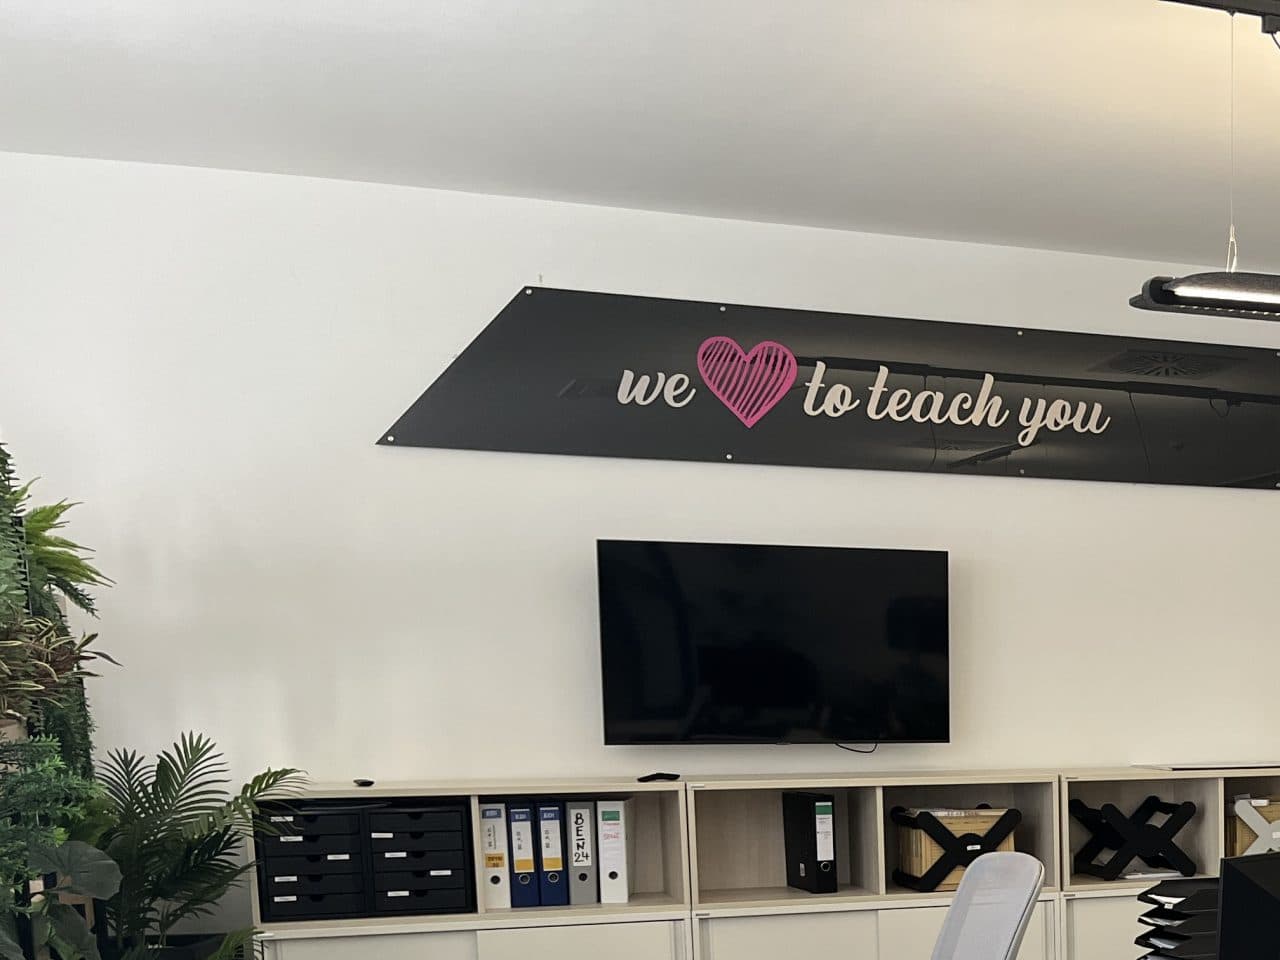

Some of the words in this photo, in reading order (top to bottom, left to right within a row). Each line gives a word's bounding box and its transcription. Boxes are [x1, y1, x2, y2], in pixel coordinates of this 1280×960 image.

[616, 368, 697, 409] we
[803, 361, 860, 417] to
[867, 365, 1009, 428] teach
[1016, 396, 1112, 447] you
[574, 852, 590, 863] 24
